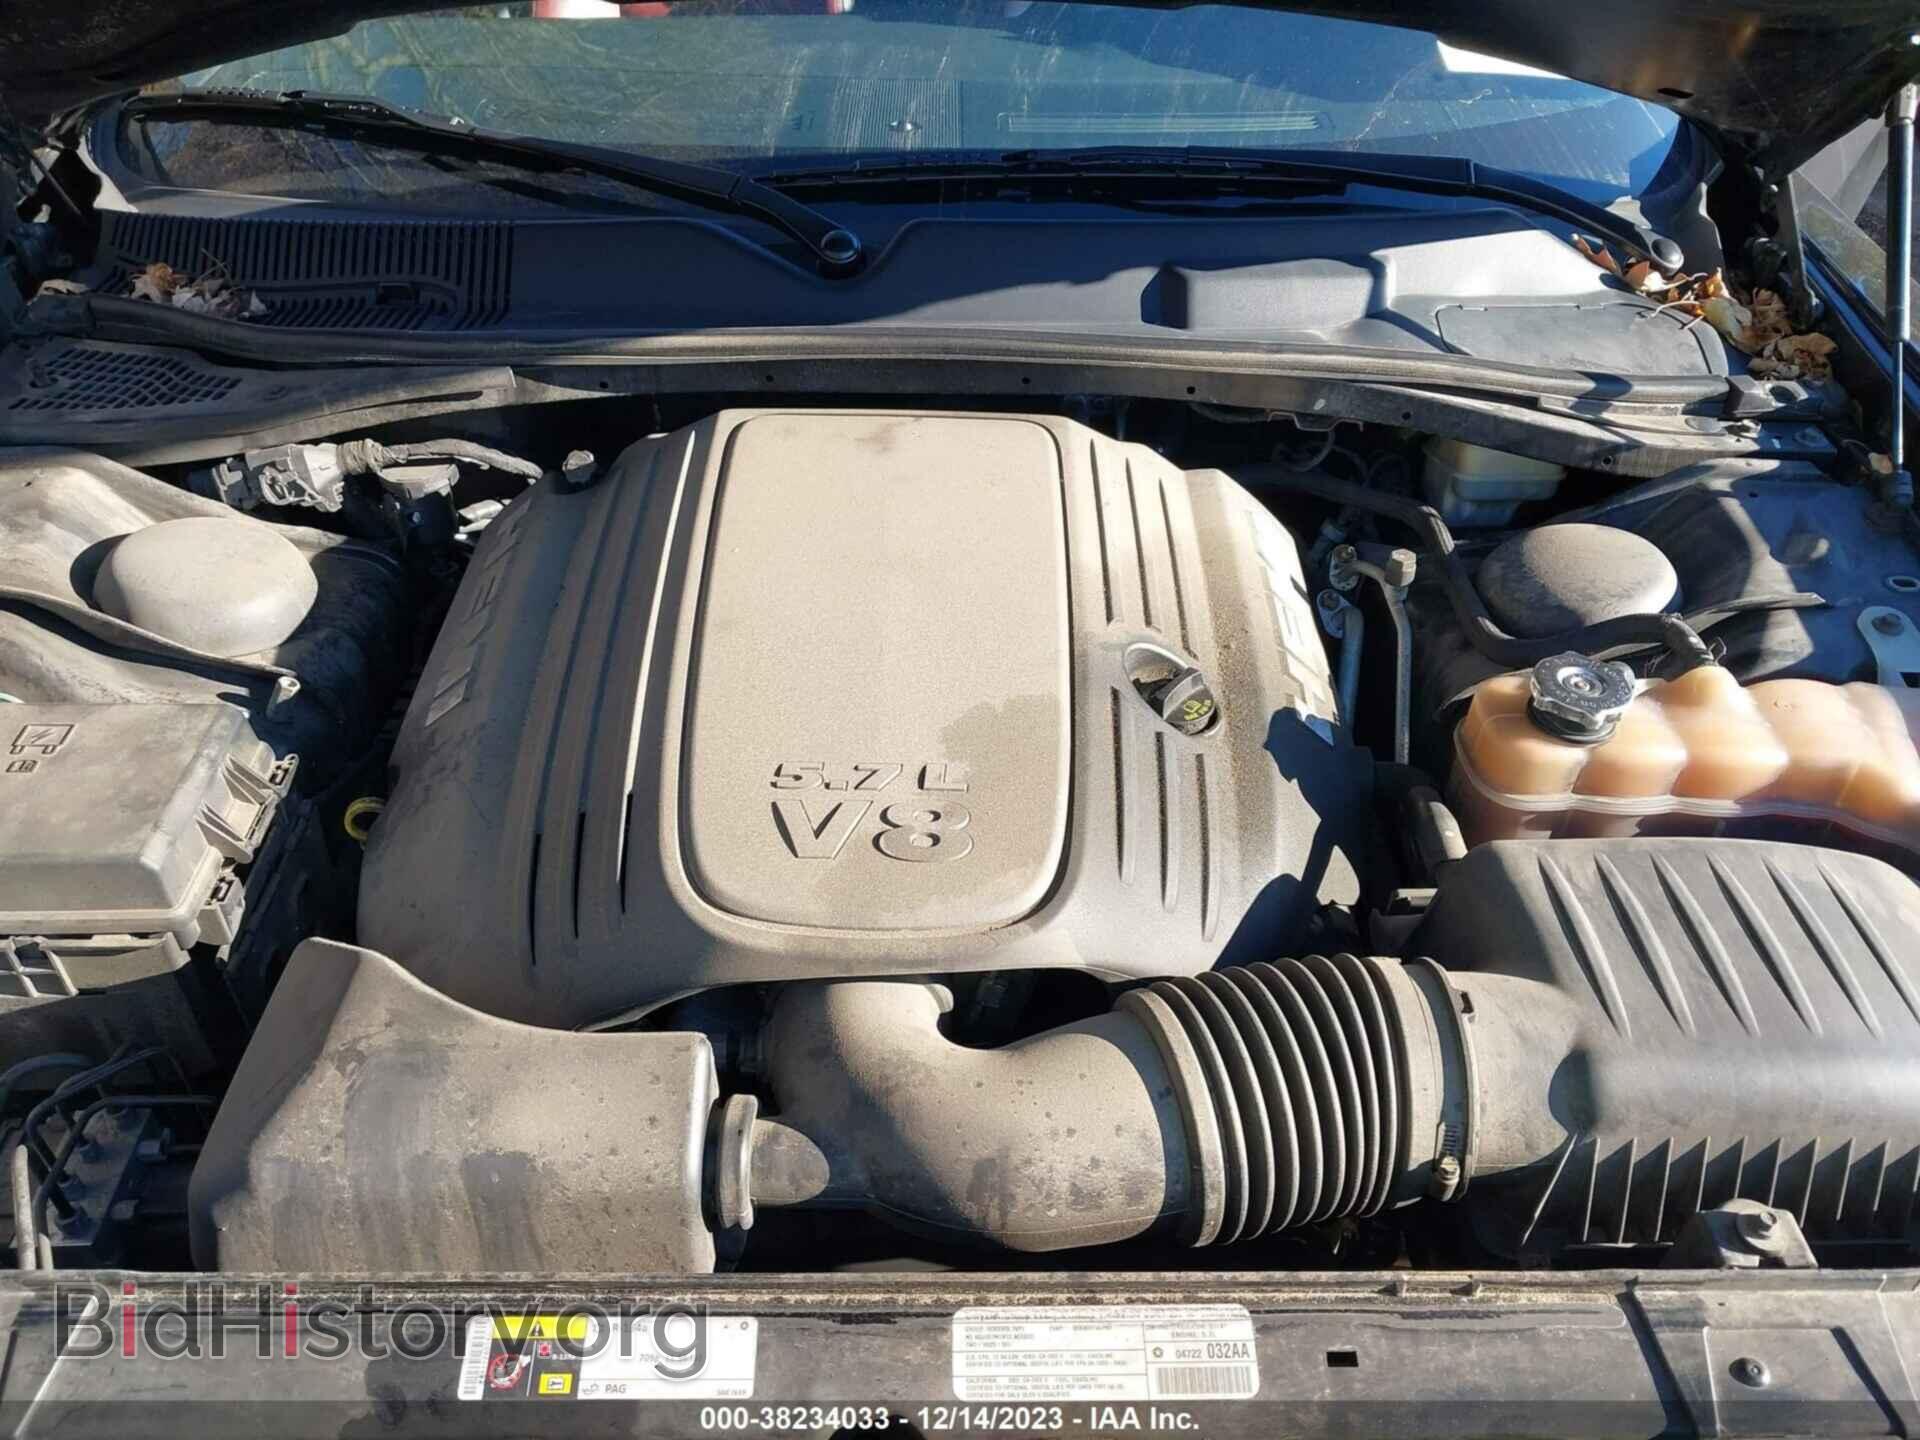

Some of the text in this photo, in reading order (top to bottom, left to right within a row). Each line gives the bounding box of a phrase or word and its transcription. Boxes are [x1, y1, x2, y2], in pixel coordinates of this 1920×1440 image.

[769, 799, 974, 863] V8
[1207, 1343, 1250, 1359] 032AA
[605, 1383, 627, 1395] PAG
